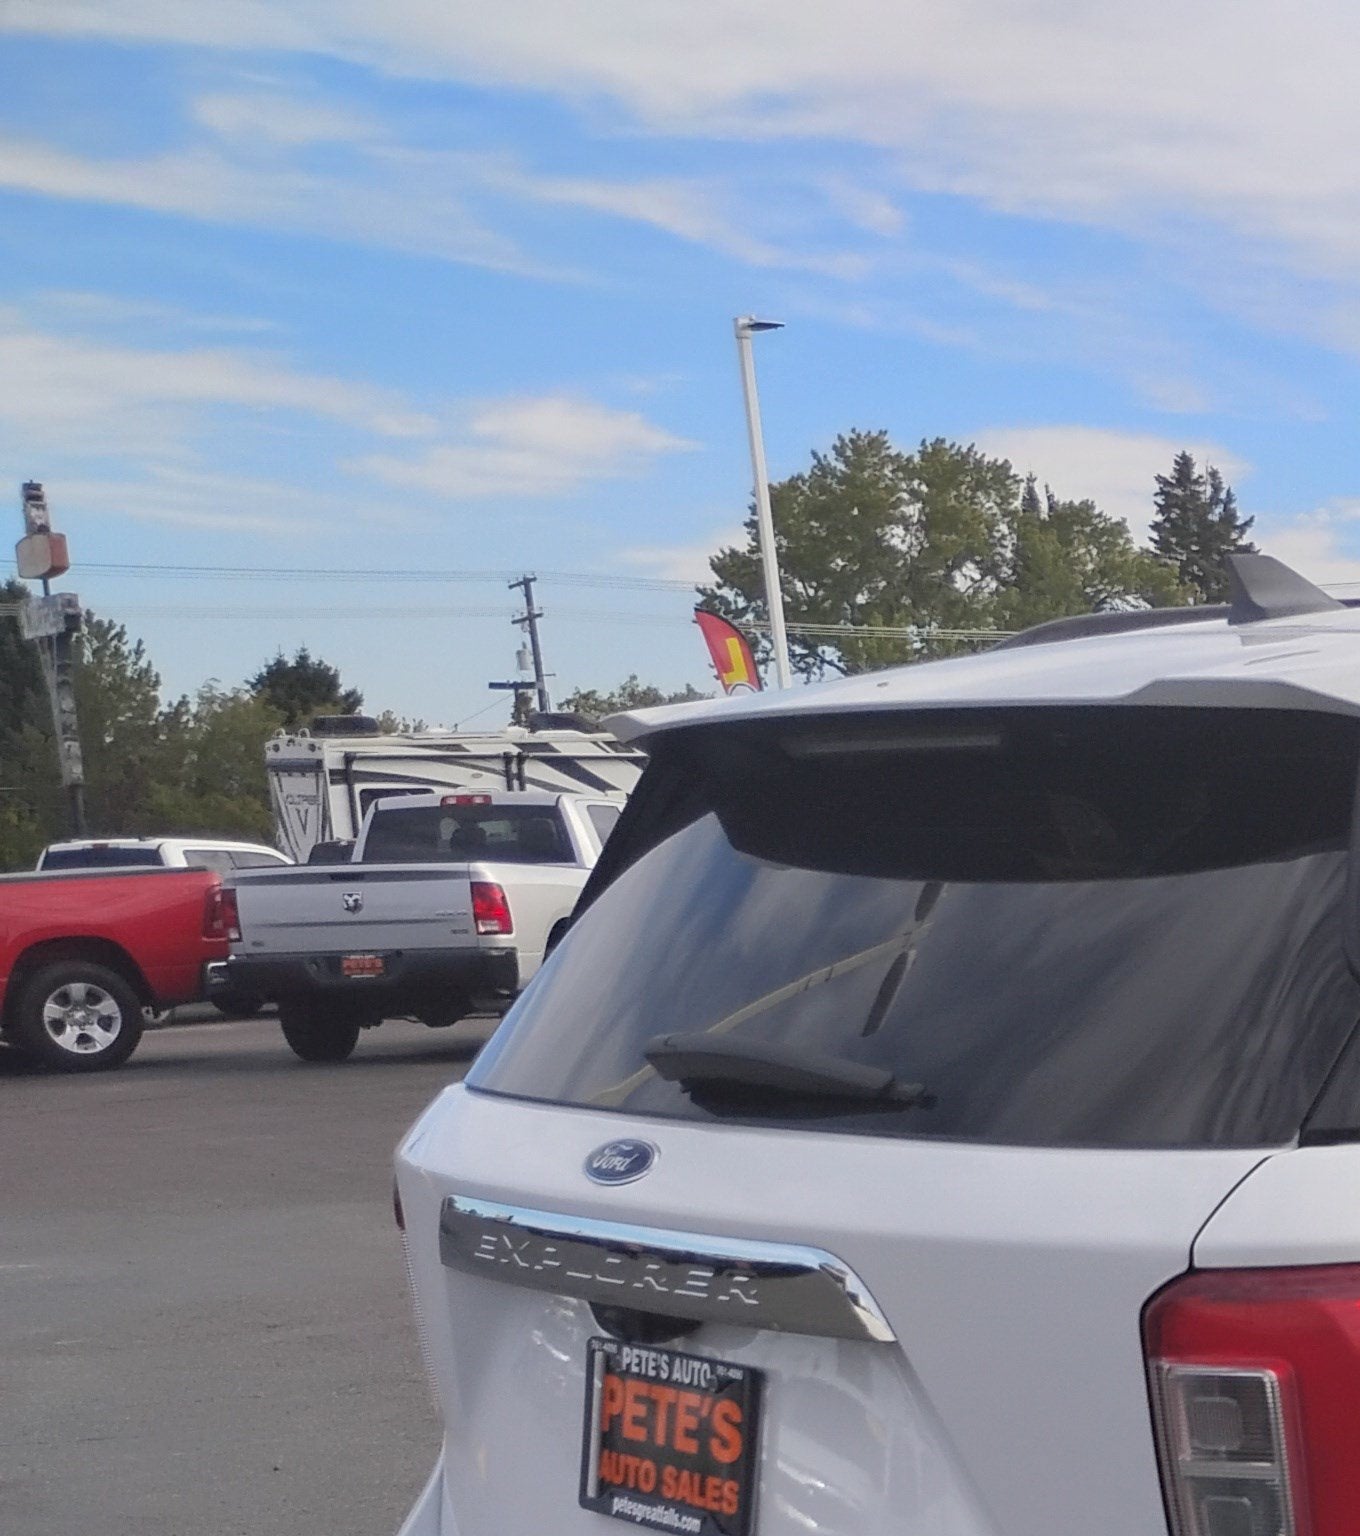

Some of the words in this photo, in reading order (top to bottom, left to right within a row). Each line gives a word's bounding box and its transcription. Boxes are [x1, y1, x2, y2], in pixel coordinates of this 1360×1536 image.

[474, 1234, 759, 1305] EXPLORER
[621, 1346, 670, 1380] PETE'S
[671, 1357, 712, 1389] AUTO
[601, 1372, 743, 1465] PETE'S
[598, 1448, 657, 1493] AUTO
[660, 1464, 740, 1516] SALES
